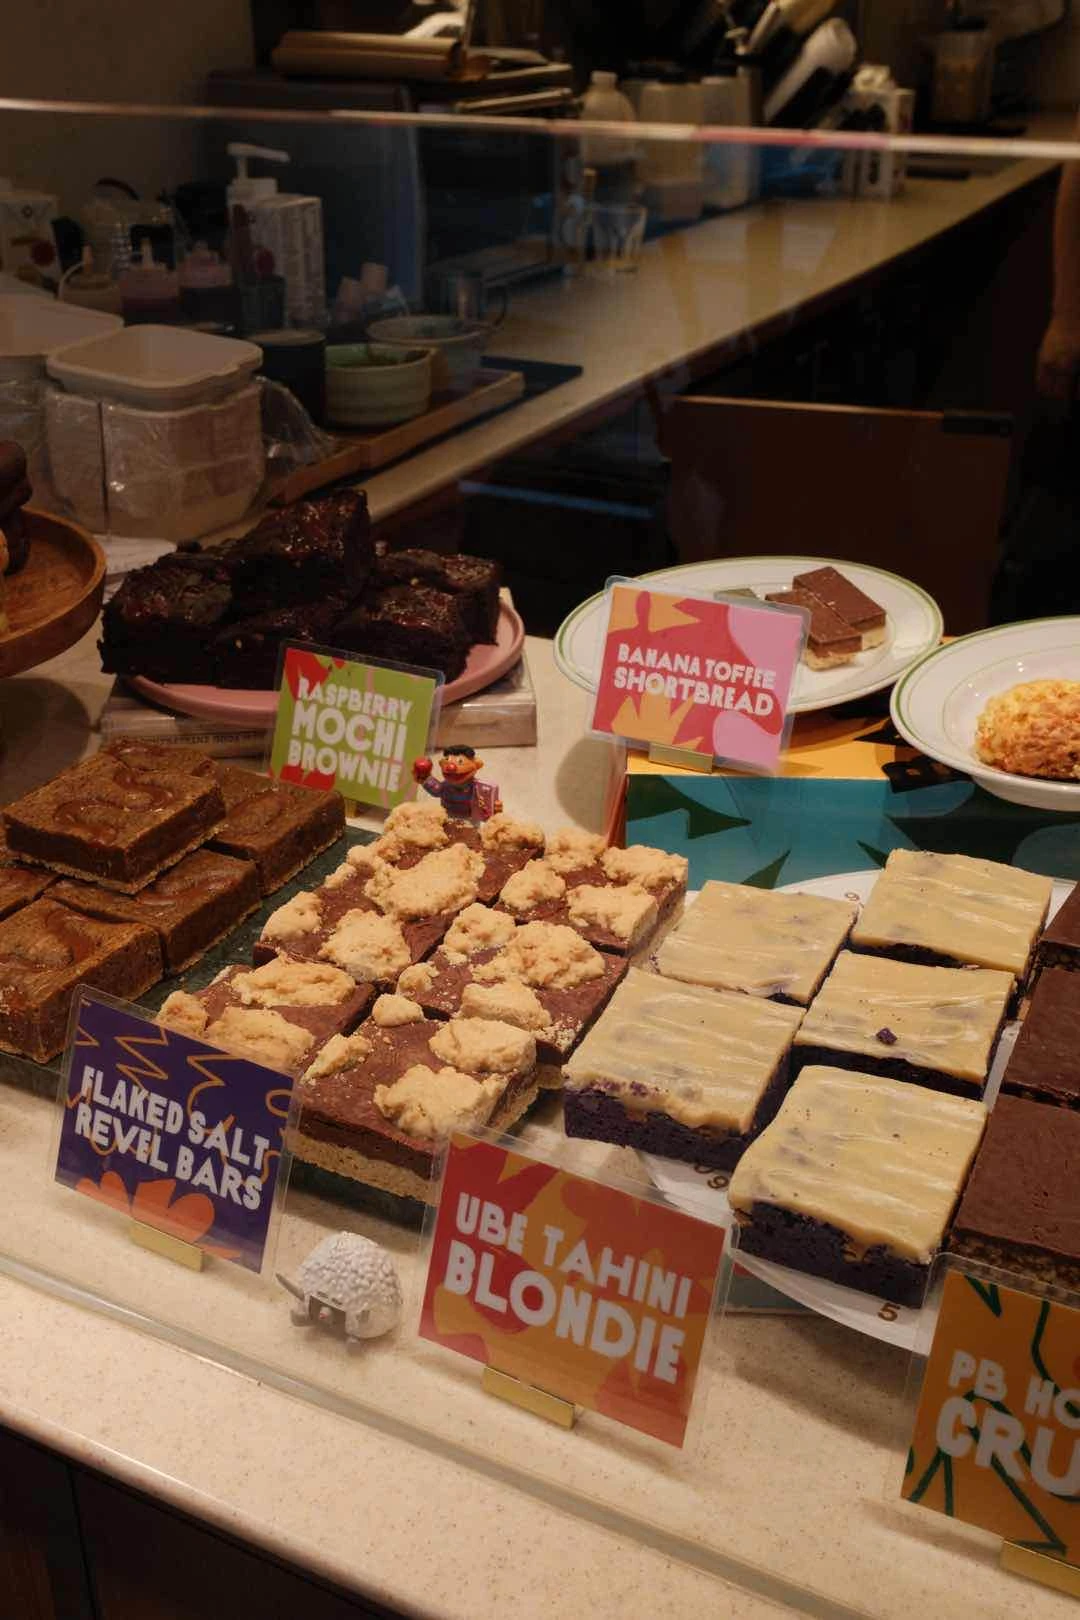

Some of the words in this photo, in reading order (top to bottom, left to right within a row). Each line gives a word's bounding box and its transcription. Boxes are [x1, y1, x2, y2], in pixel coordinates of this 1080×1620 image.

[613, 666, 774, 716] SHORTBREAD
[617, 643, 700, 675] BANANA
[705, 659, 777, 689] TOFFEE
[298, 676, 412, 722] RASPBERRY
[292, 702, 407, 762] MOCHI
[287, 739, 402, 792] BROWNIE
[81, 1065, 184, 1135] FLAKED
[188, 1111, 270, 1170] SALT
[74, 1102, 169, 1172] REVEL
[175, 1145, 263, 1211] BARS
[456, 1191, 528, 1255] UBE
[543, 1224, 693, 1319] TAHINI
[444, 1239, 686, 1385] BLONDIE
[877, 1303, 900, 1322] 5
[949, 1350, 1007, 1401] PB
